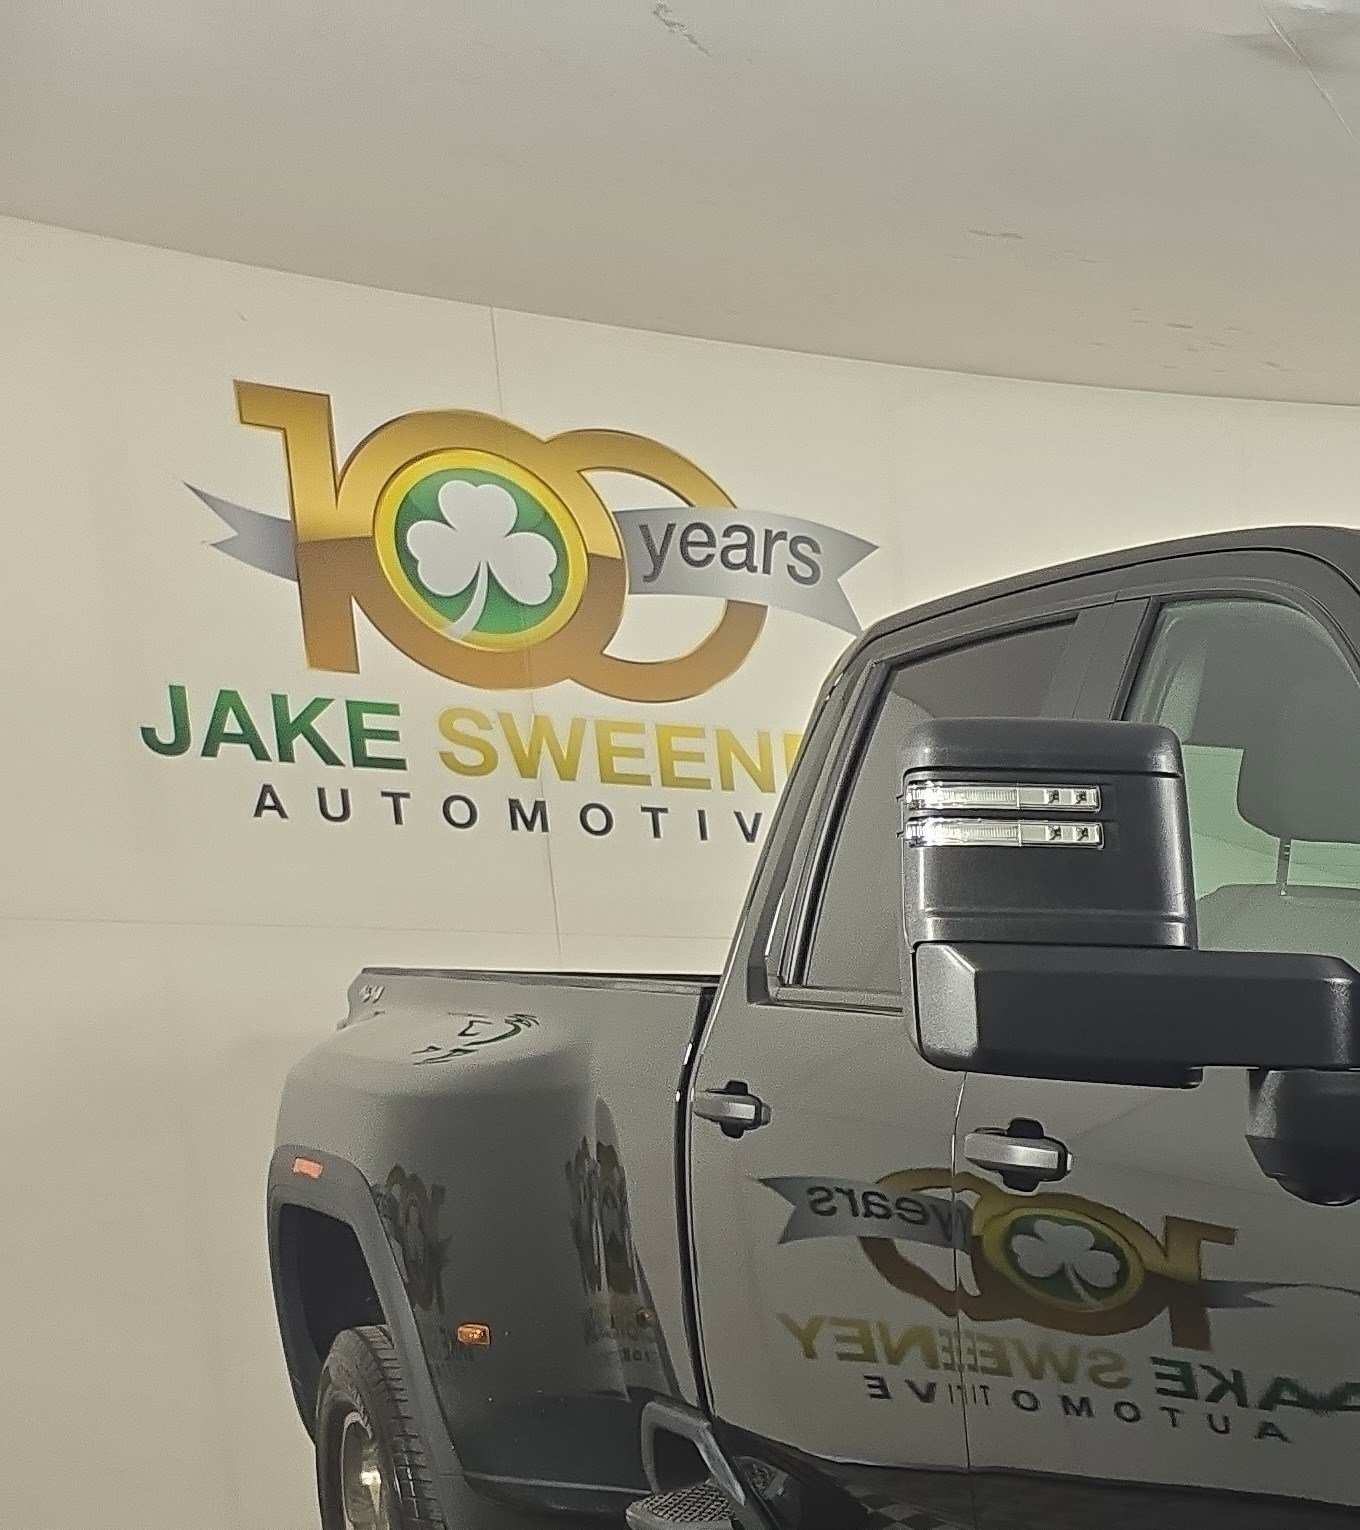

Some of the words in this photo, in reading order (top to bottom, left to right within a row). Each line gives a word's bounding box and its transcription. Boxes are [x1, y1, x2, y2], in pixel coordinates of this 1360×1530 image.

[232, 379, 768, 703] 100
[638, 520, 823, 587] years
[140, 684, 407, 771] JAKE
[253, 784, 763, 843] AUTOMOTIV
